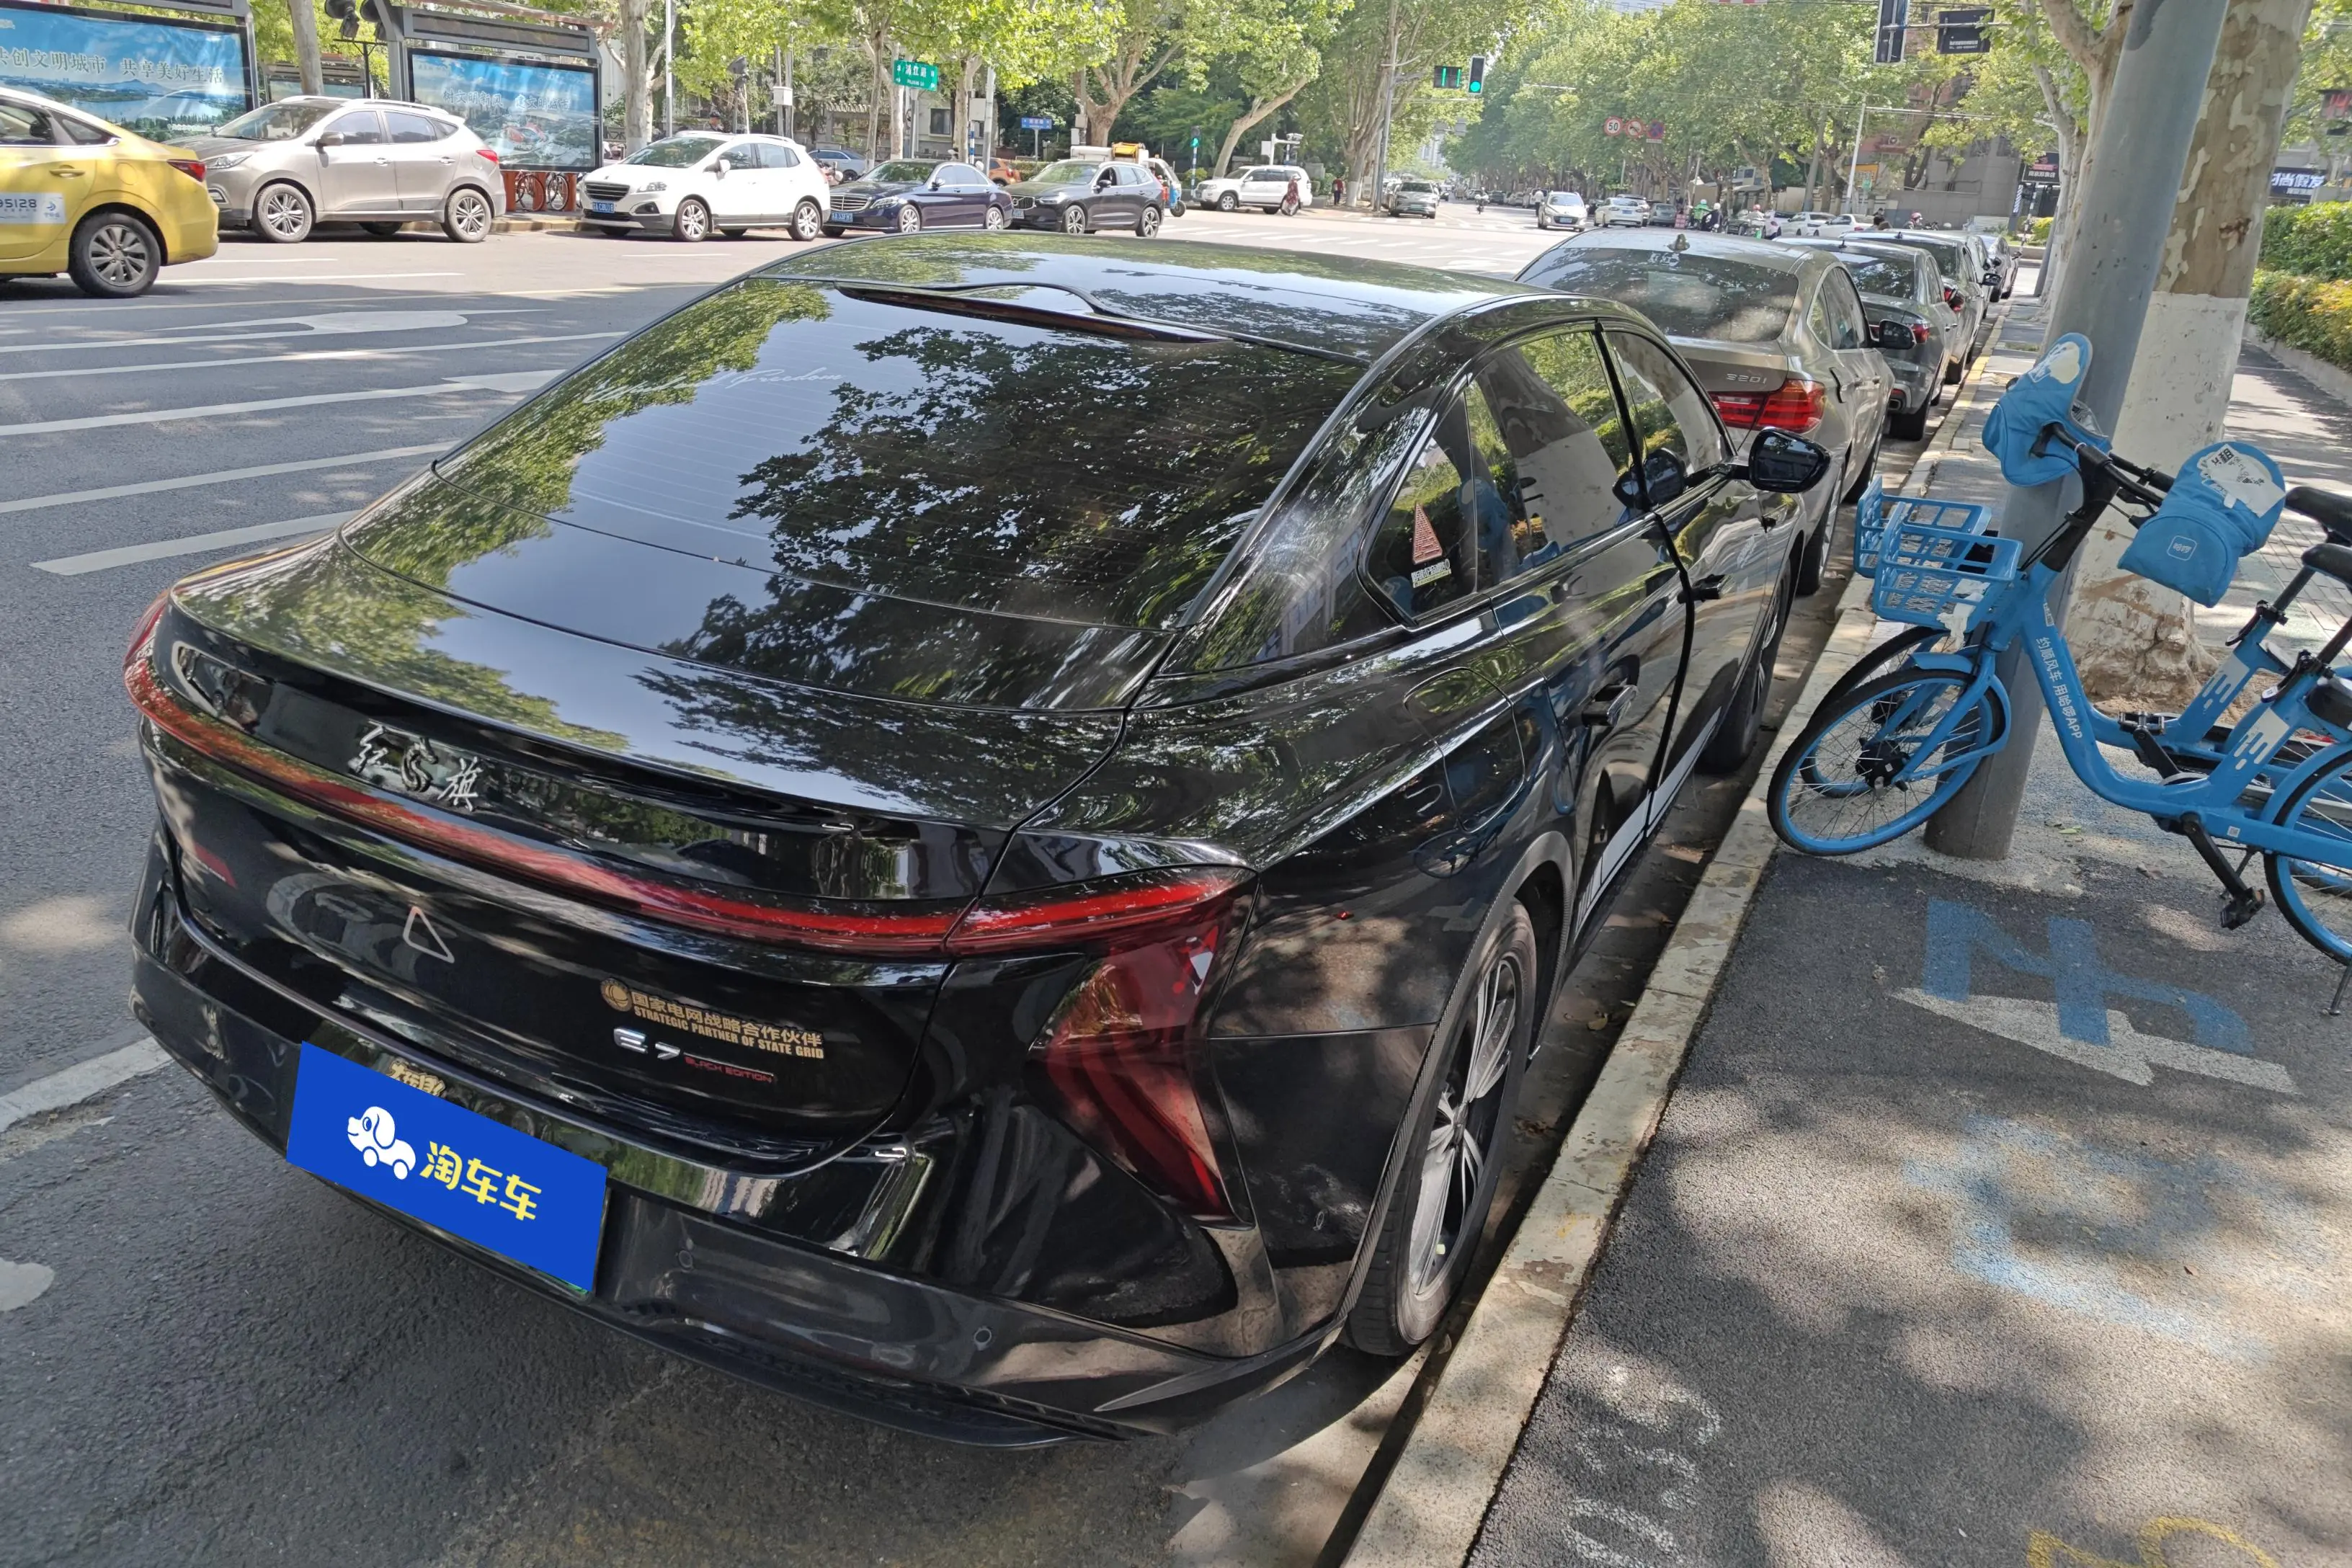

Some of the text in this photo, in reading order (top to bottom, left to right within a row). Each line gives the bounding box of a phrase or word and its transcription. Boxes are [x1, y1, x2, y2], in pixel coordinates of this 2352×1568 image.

[0, 46, 223, 84] 共创文明城市 共享美好生活
[442, 88, 571, 110] 树文明新风 建文明城市
[1608, 122, 1618, 130] 50
[2036, 637, 2083, 739] 约顺风车 用哈啰APP
[355, 718, 484, 812] 红旗
[631, 991, 823, 1047] 国家电网战略合作伙伴
[633, 1005, 824, 1059] STRATEGIC PARTNER OF STATE GRID
